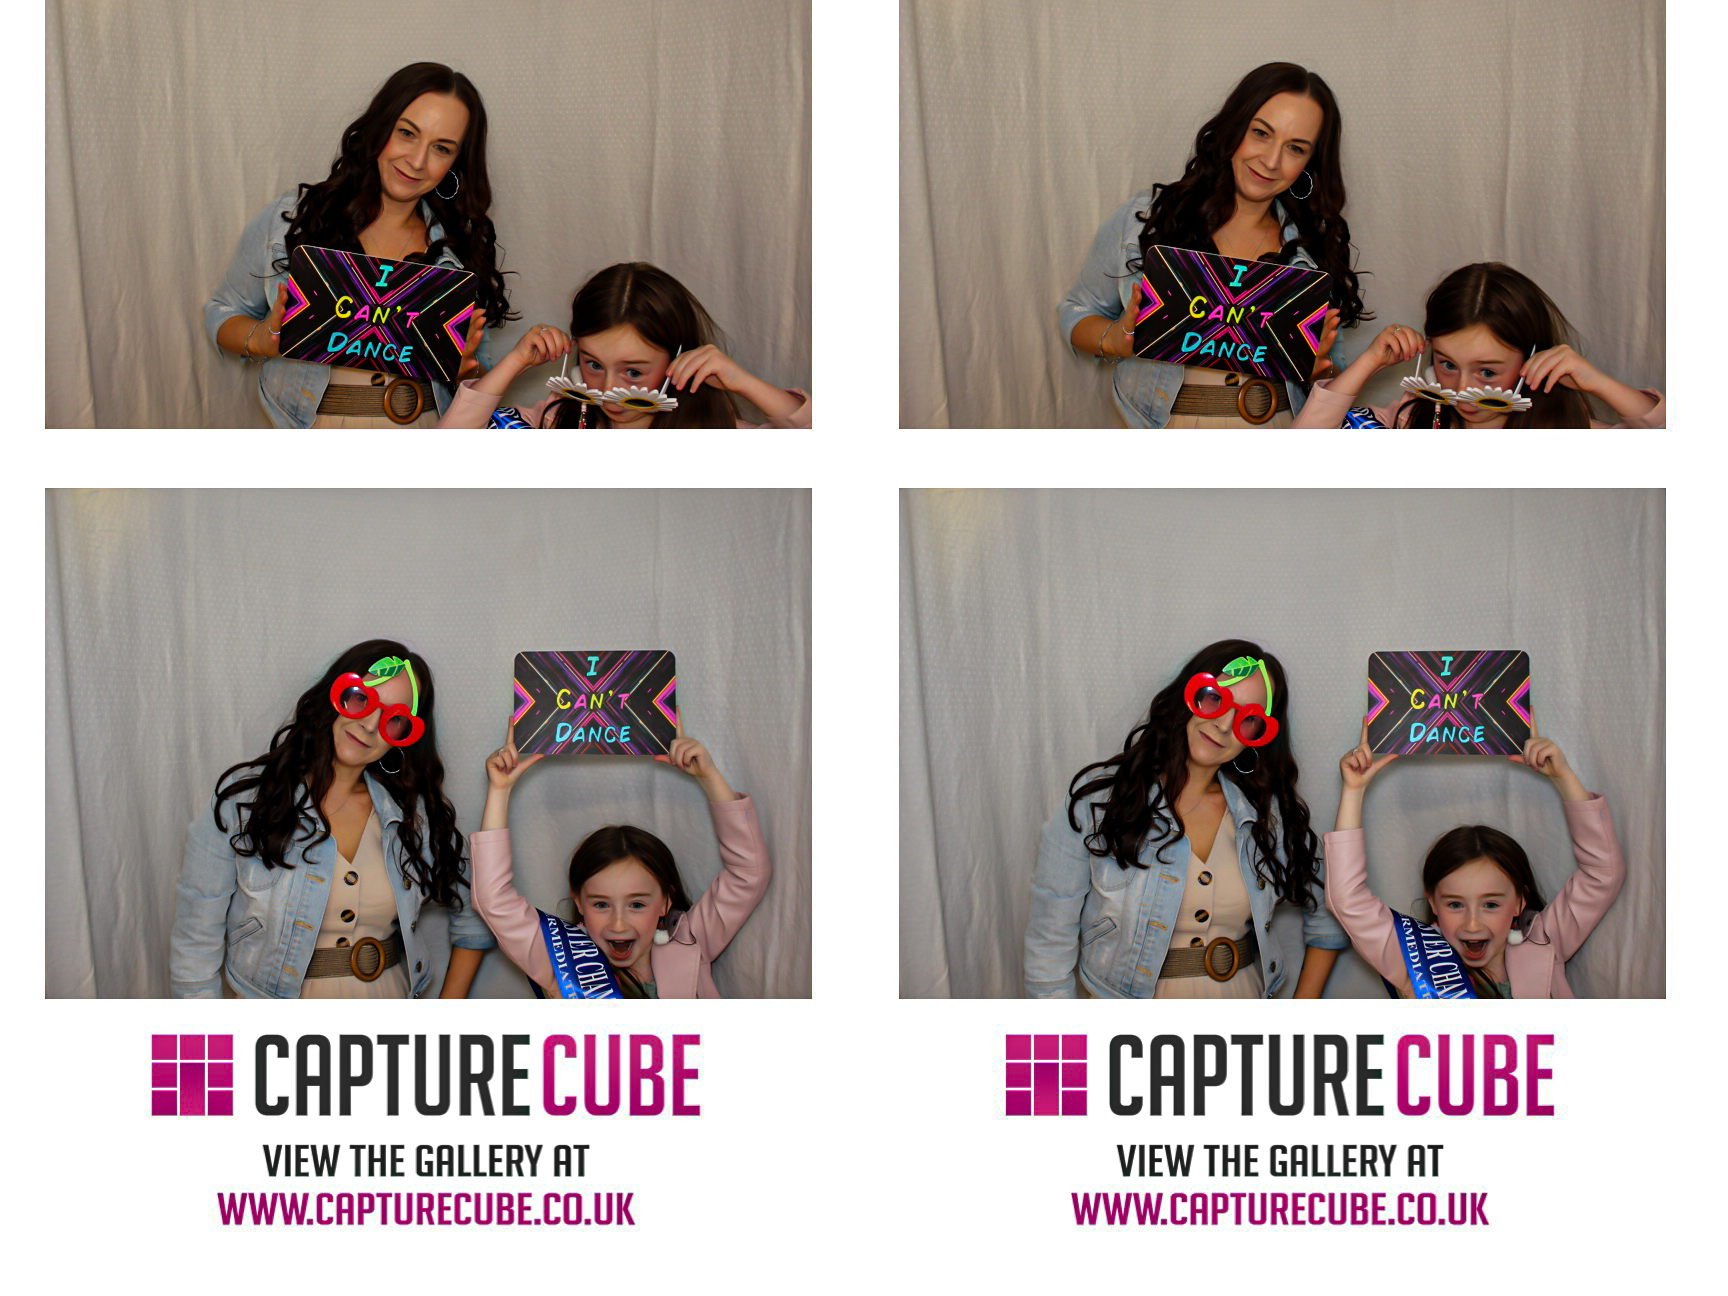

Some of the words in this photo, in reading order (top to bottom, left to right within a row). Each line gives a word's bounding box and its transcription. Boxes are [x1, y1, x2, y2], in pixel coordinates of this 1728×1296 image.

[374, 264, 394, 287] I
[1228, 264, 1248, 287] I
[335, 295, 420, 328] CAN'T
[1189, 295, 1274, 328] CAN'T
[327, 331, 414, 363] DANCE
[1181, 331, 1268, 363] DANCE
[586, 656, 600, 677] I
[1440, 656, 1454, 677] I
[556, 688, 631, 710] CAN'T
[1410, 688, 1485, 710] CAN'T
[555, 722, 631, 743] DANCE
[1409, 722, 1485, 743] DANCE
